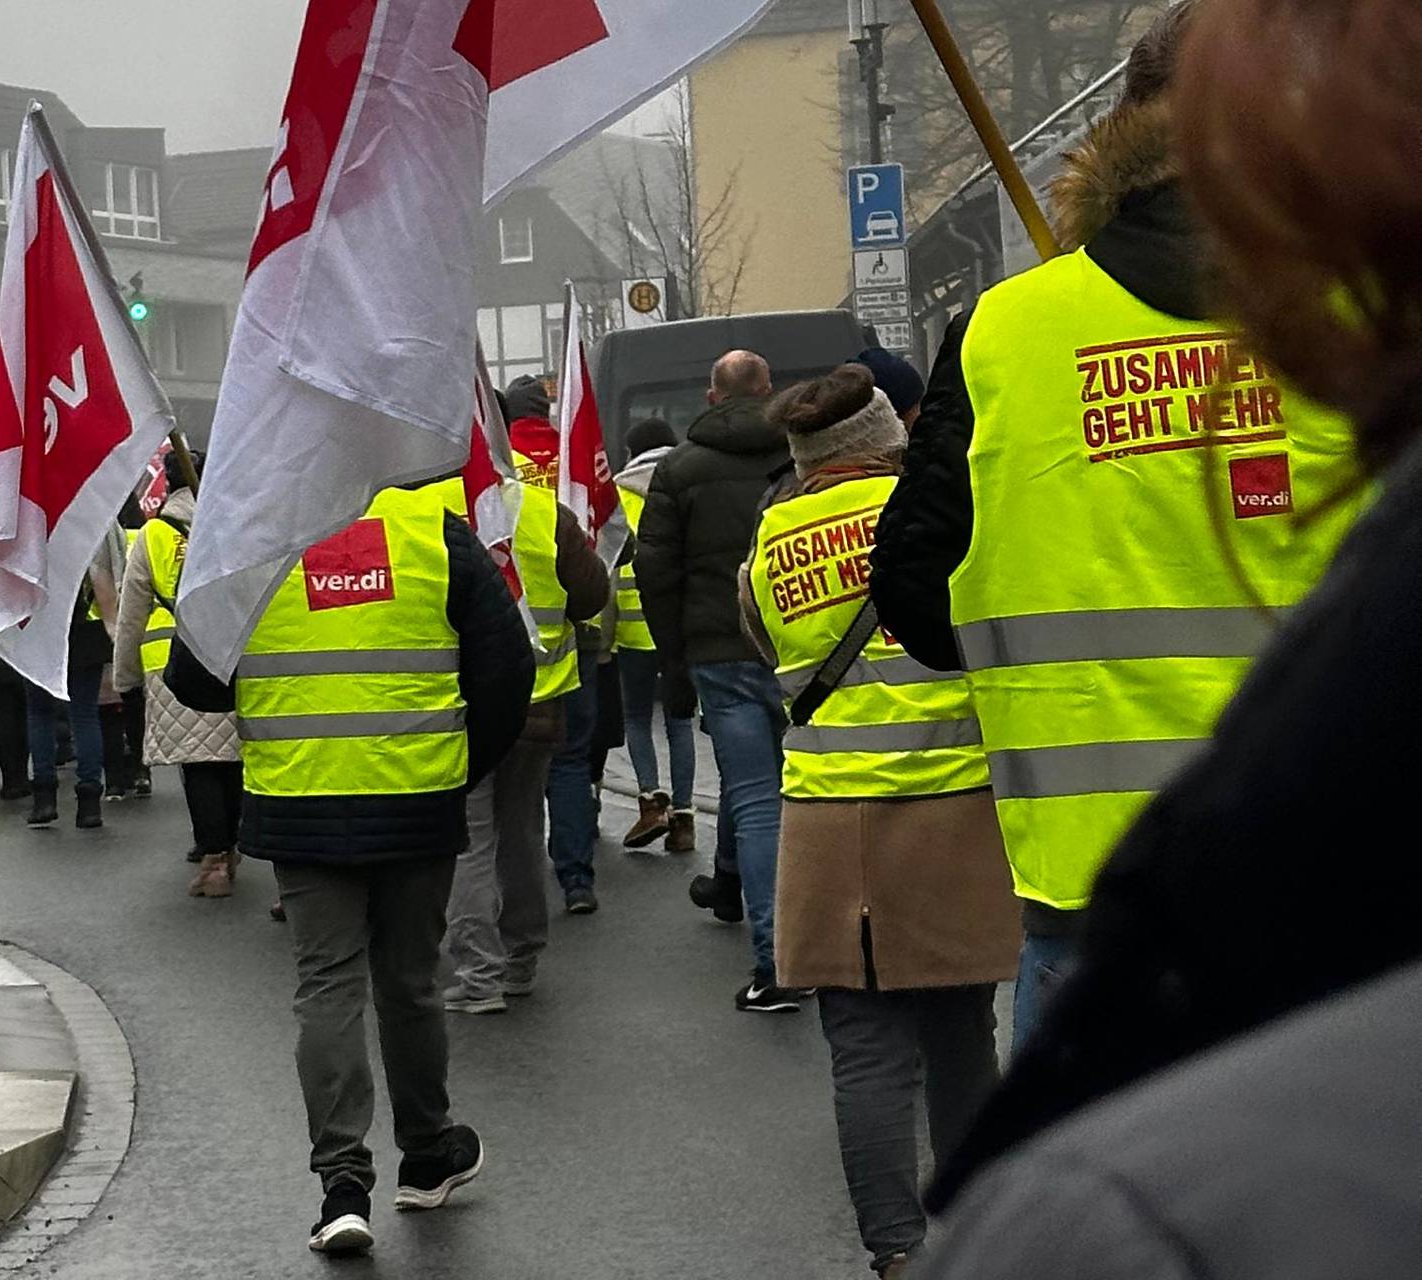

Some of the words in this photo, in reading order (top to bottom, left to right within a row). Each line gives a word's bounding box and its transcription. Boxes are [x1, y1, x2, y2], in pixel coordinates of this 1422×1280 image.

[857, 174, 879, 204] P
[1083, 396, 1175, 448] GEHT
[1186, 383, 1285, 433] MEHR
[1237, 491, 1290, 507] ver.di
[765, 513, 879, 580] ZUSAMME
[310, 569, 386, 592] ver.di
[772, 565, 830, 614] GEHT
[836, 552, 872, 590] ME
